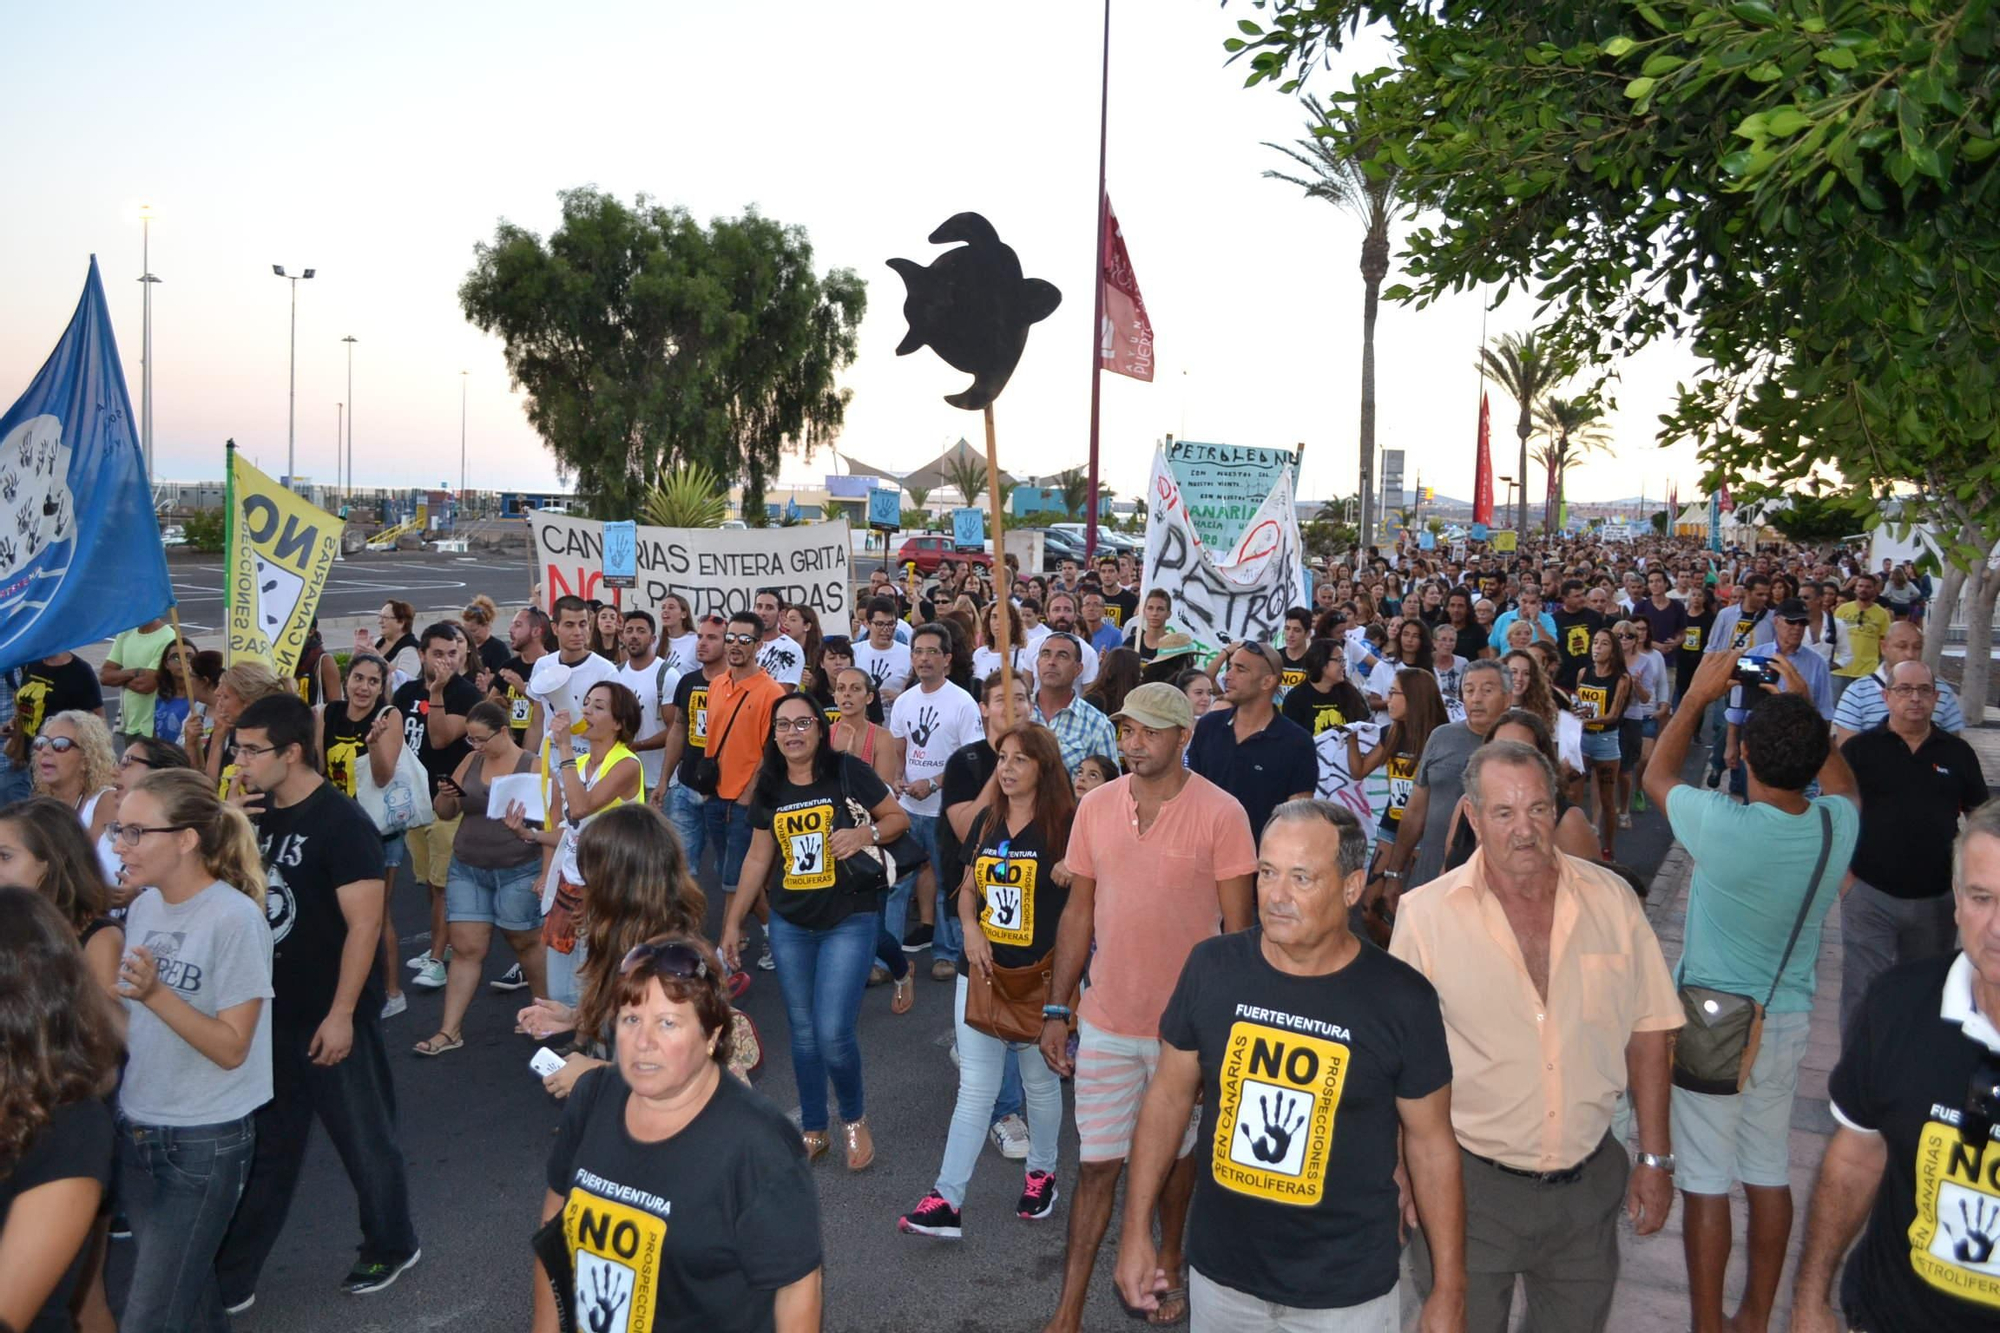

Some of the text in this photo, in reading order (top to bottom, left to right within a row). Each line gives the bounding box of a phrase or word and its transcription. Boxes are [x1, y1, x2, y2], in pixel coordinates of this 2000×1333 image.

[542, 524, 847, 576] CANRIAS ENTERA GRITA
[1281, 674, 1298, 685] NO
[1582, 689, 1599, 701] NO
[912, 749, 926, 760] NO
[775, 798, 833, 812] FUERTEVENTURA
[786, 812, 821, 834] NO
[276, 832, 309, 867] 13
[1023, 866, 1033, 932] PROSPECCIONES
[1235, 1003, 1350, 1041] FUERTEVENTURA
[1248, 1036, 1320, 1086] NO
[1216, 1034, 1248, 1160] EN CANARIAS
[1306, 1055, 1341, 1180] PROSPECCIONES
[574, 1167, 672, 1215] FUERTEVENTURA
[1215, 1161, 1316, 1196] PETROLÍFERAS
[1911, 1134, 1943, 1251] EN CANARIAS
[578, 1206, 641, 1260] NO
